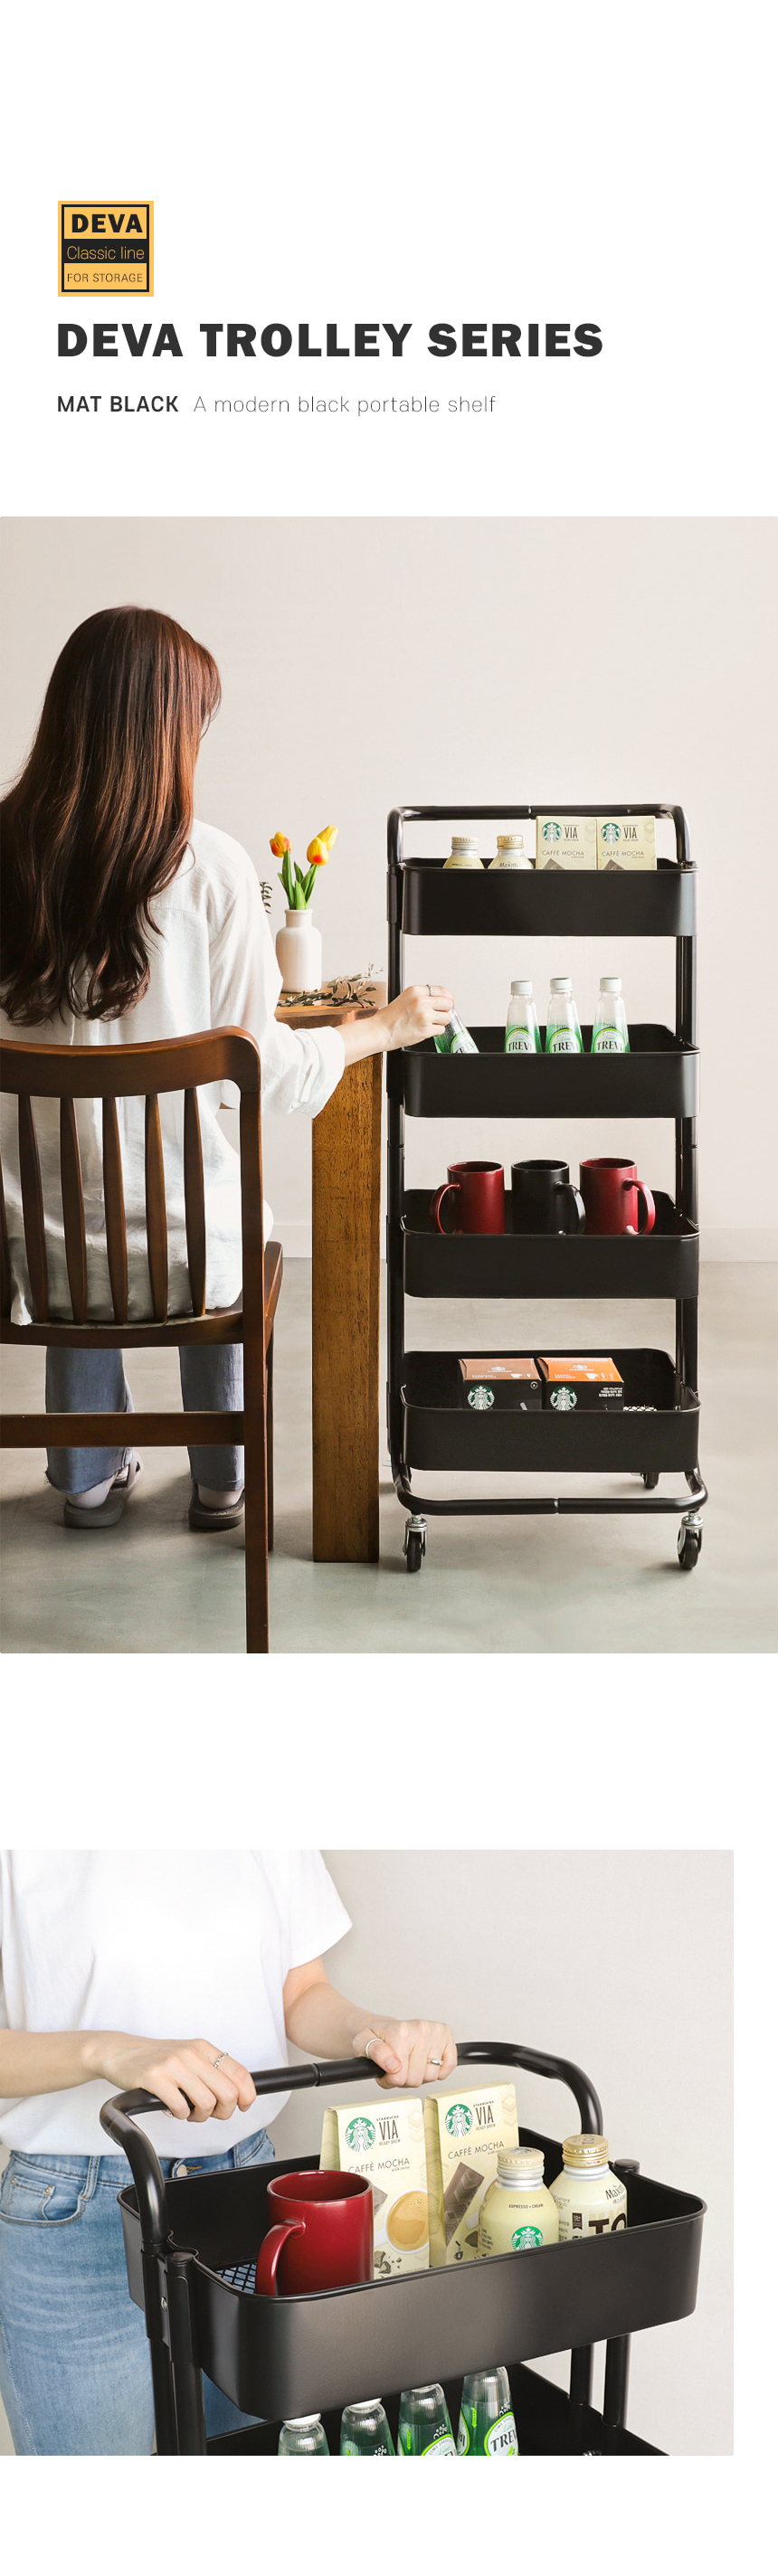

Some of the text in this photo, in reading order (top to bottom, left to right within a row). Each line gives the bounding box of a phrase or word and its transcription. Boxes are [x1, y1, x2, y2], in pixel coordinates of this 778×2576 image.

[565, 827, 578, 838] VIA
[623, 827, 638, 839] VIA
[475, 2105, 495, 2126] VIA
[378, 2119, 399, 2141] VIA
[474, 2140, 505, 2154] MOCHA
[377, 2157, 411, 2170] MOCHA
